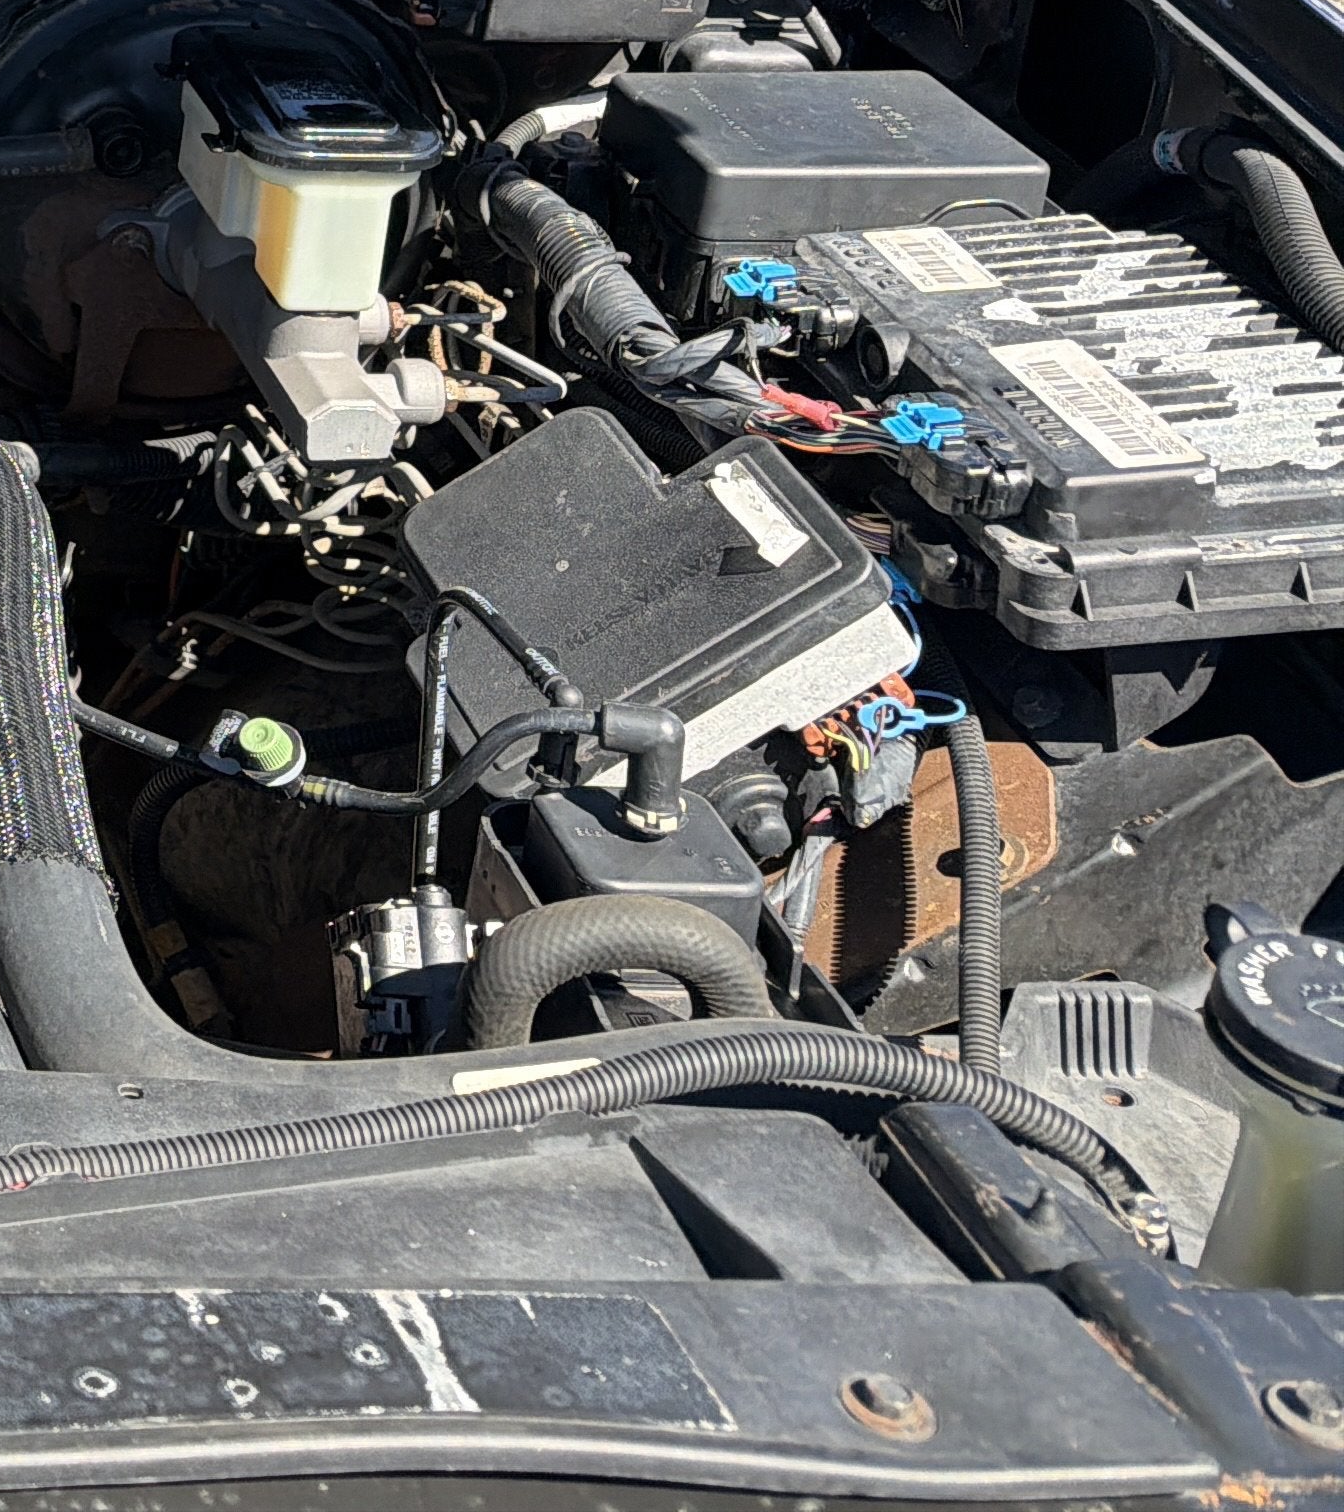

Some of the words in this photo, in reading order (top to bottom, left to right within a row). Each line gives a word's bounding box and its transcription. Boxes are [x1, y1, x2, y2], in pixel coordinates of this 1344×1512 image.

[439, 635, 449, 662] FUEL
[434, 674, 447, 736] FLAMMABLE
[431, 748, 443, 771] NOT
[1237, 941, 1295, 1006] WASHER
